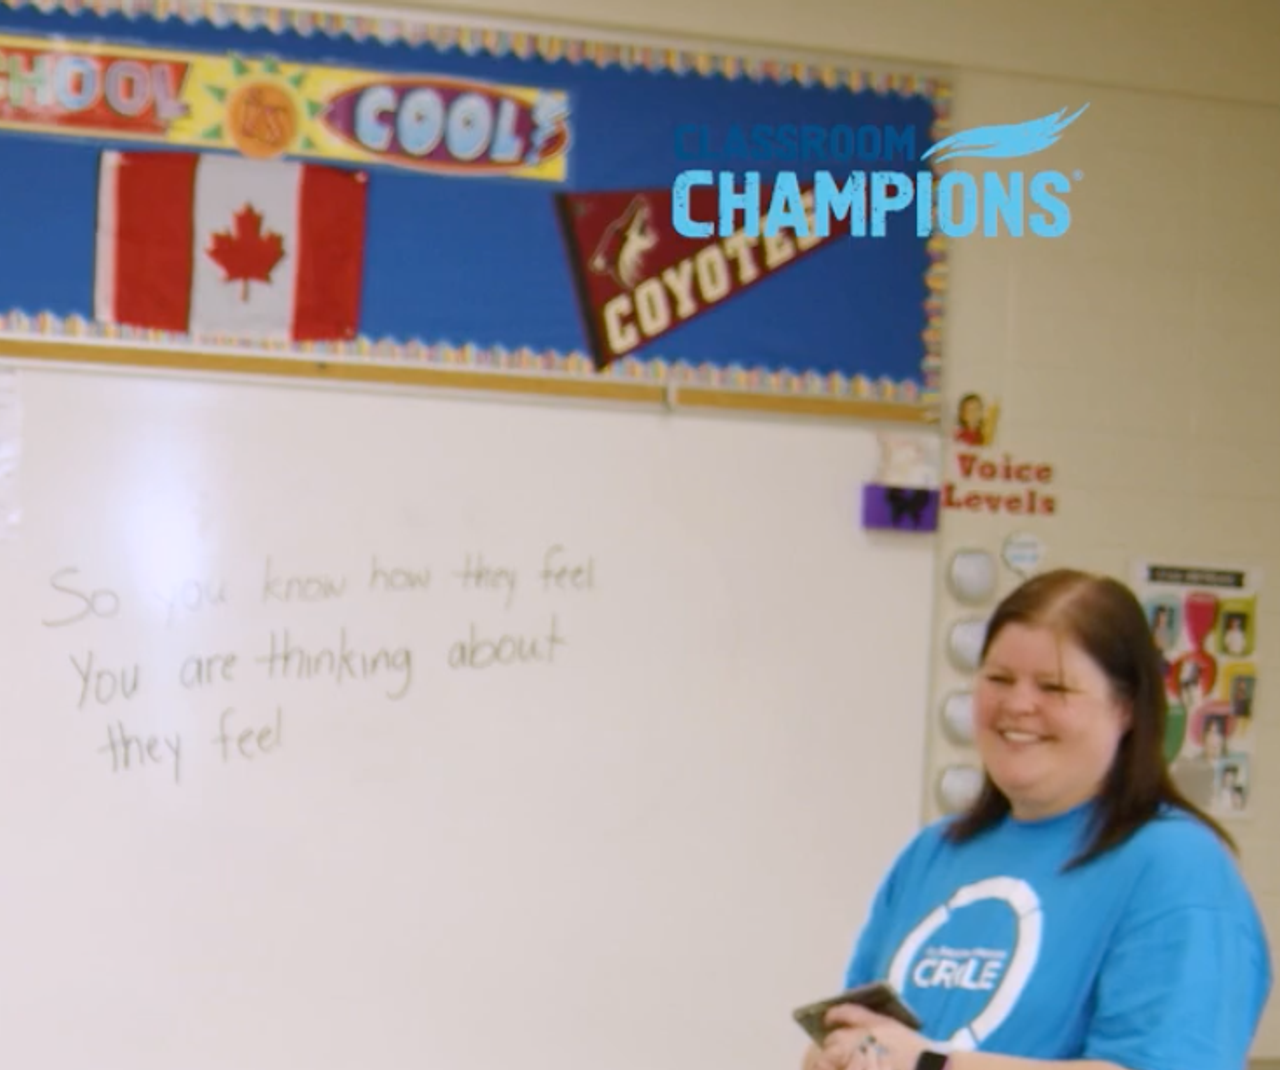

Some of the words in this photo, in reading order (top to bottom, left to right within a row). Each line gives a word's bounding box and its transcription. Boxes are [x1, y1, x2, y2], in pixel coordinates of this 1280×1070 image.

[940, 484, 1057, 516] Levels
[956, 453, 1054, 484] Voice
[40, 566, 121, 628] So
[261, 554, 346, 605] know
[369, 553, 432, 593] how
[452, 552, 519, 610] they
[539, 543, 597, 592] feel
[179, 652, 238, 690] are
[254, 627, 413, 701] thinking
[447, 613, 568, 671] about
[97, 719, 182, 784] they
[211, 705, 283, 763] feel
